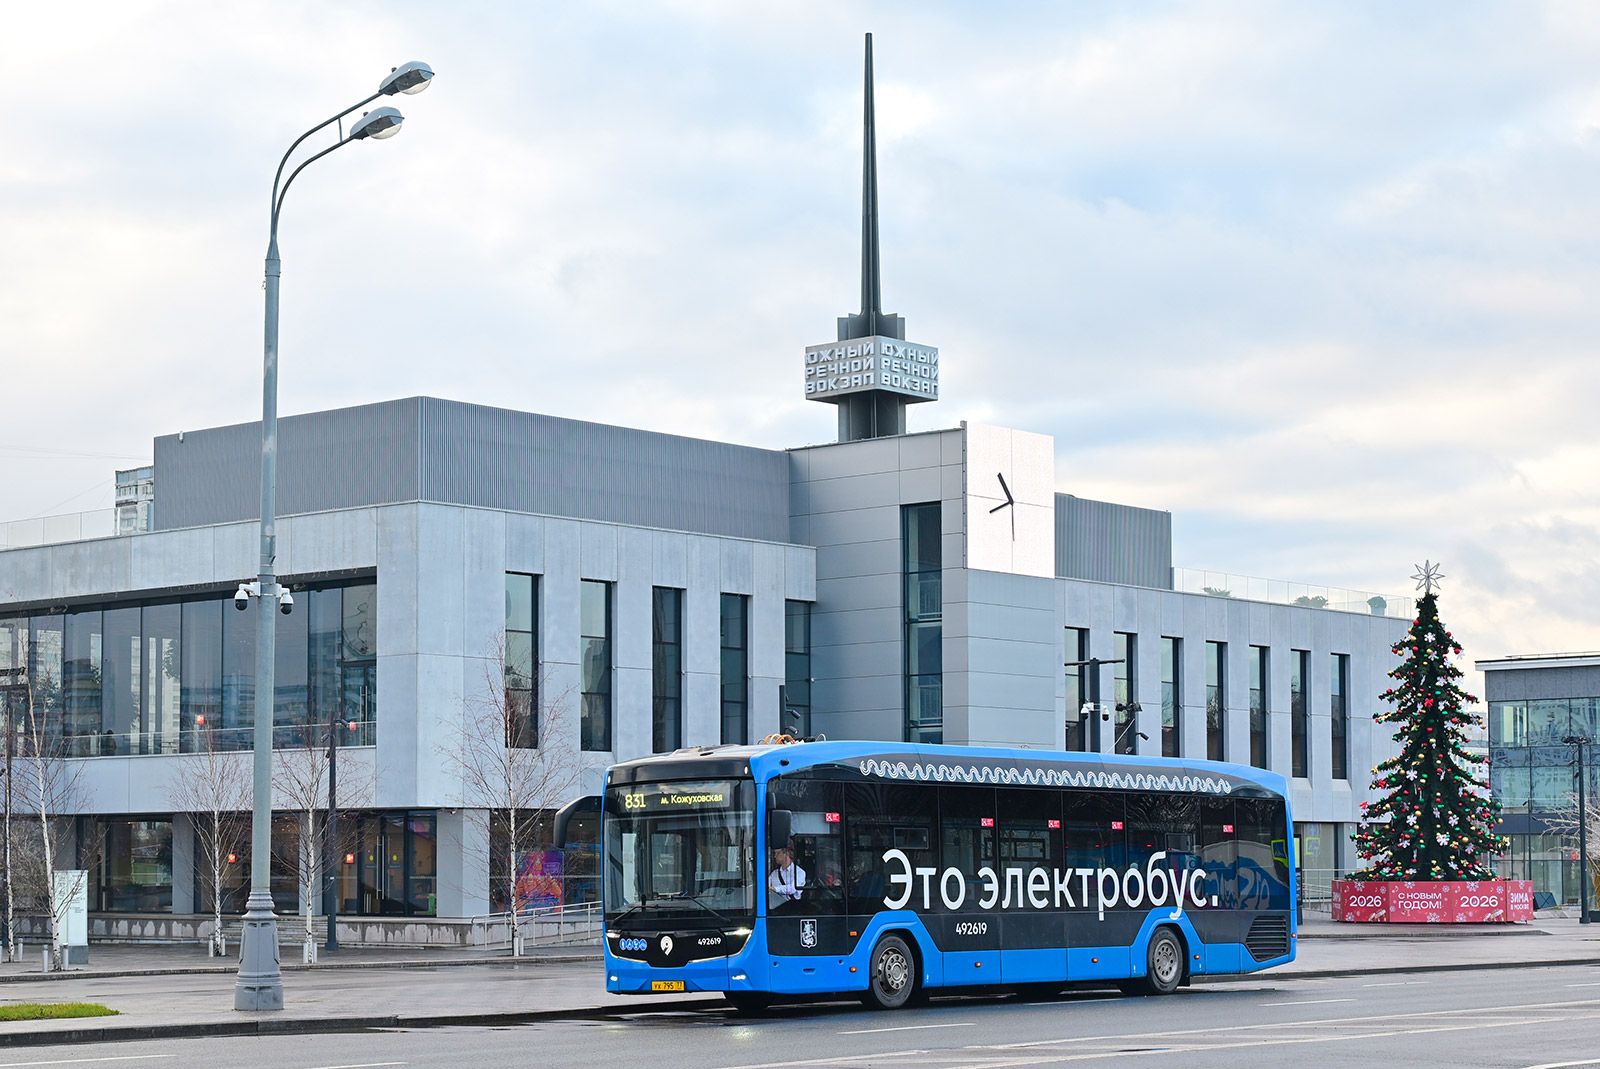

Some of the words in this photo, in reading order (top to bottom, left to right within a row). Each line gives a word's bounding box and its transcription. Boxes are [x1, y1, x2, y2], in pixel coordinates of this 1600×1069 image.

[880, 342, 939, 365] ЮЖНЫЙ
[806, 356, 874, 379] РЕЧНОЙ
[880, 357, 939, 379] РЕЧНОЙ
[806, 372, 874, 394] ВОКЗАЛ
[625, 793, 647, 809] 831
[671, 793, 723, 805] Кожуховская
[882, 849, 966, 910] Это
[977, 851, 1219, 921] электробус.
[1349, 895, 1382, 907] 2026
[1398, 892, 1406, 900] С
[1407, 892, 1442, 900] НОВЫМ
[1460, 895, 1499, 907] 2026
[1398, 900, 1442, 910] ГОДОМ!
[955, 922, 988, 935] 492619
[697, 937, 722, 946] 492619
